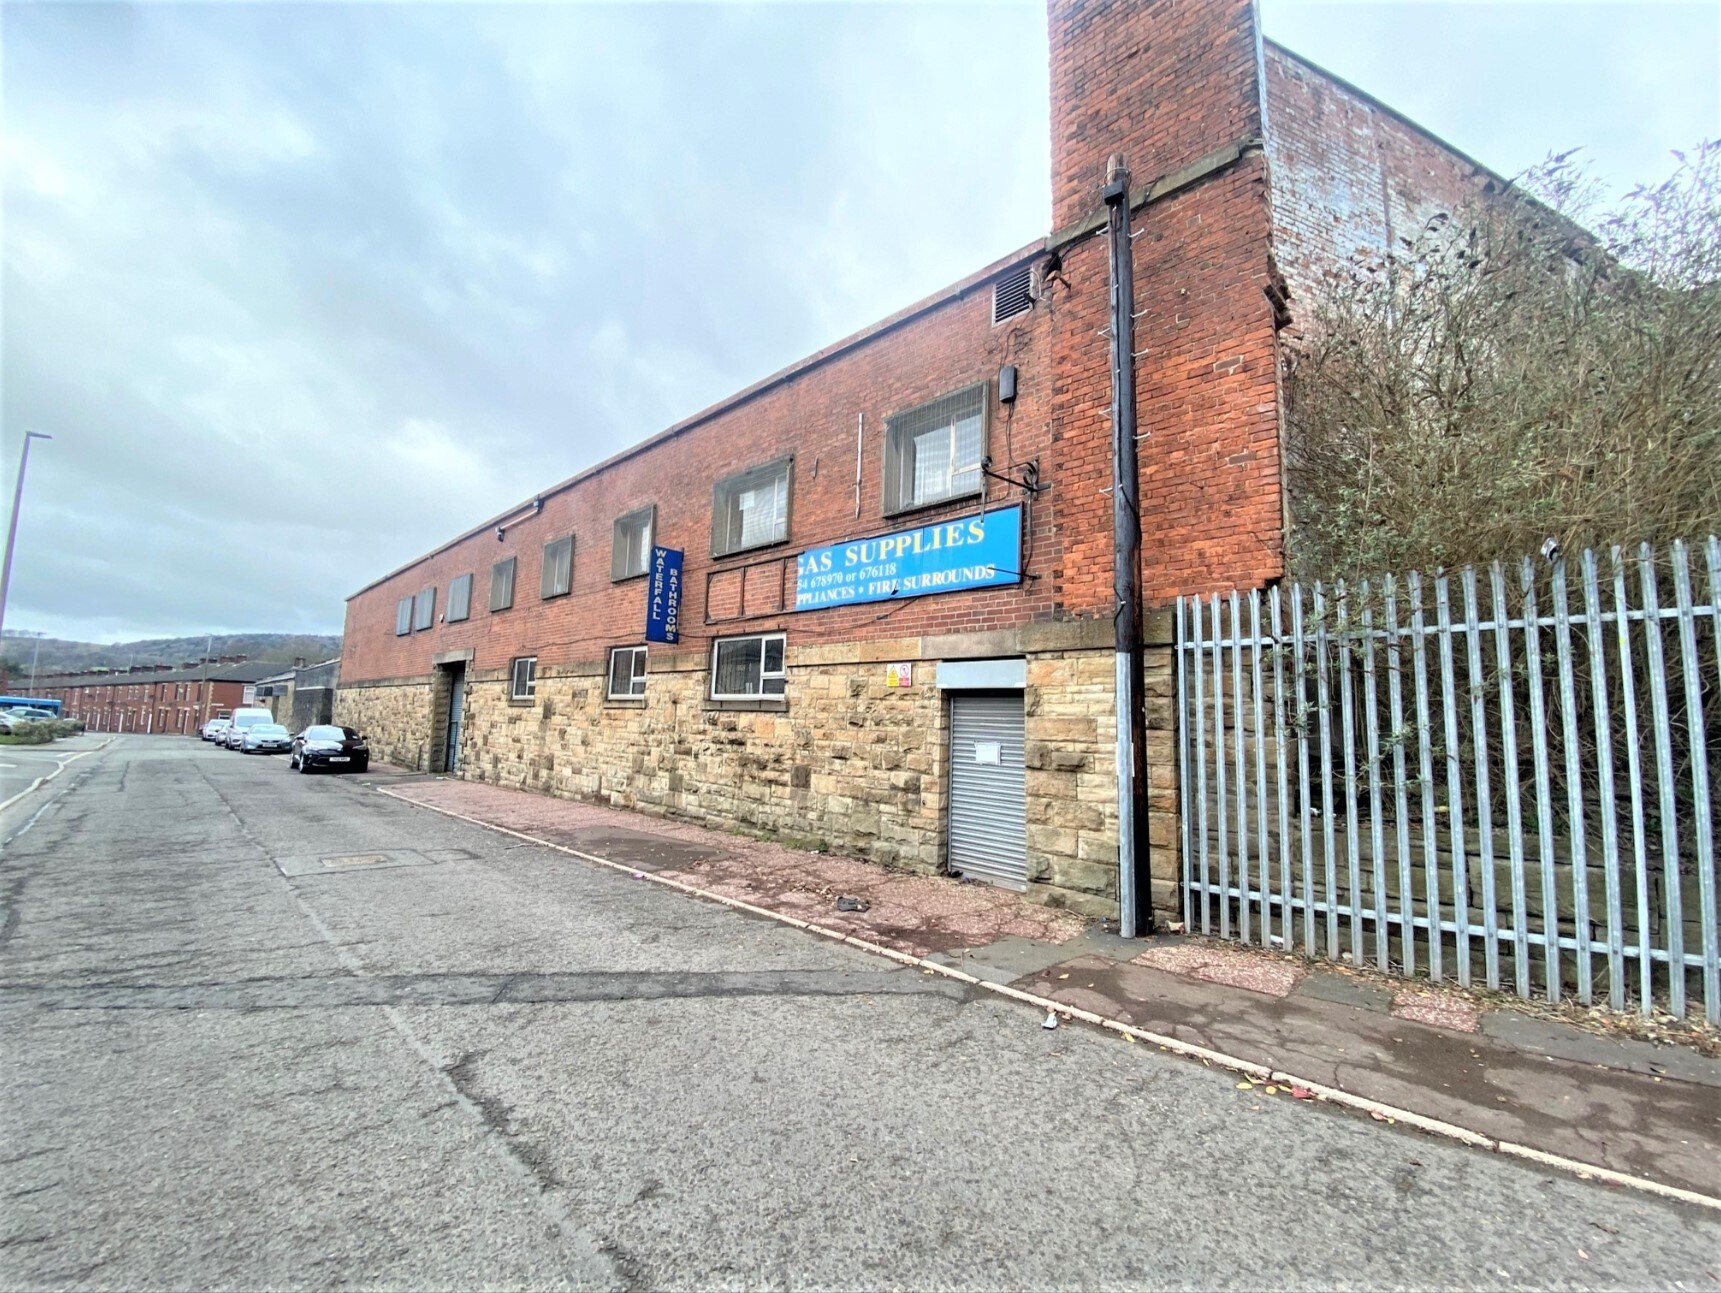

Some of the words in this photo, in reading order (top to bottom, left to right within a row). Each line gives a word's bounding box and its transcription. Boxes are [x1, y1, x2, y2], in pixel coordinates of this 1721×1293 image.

[845, 520, 985, 567] SUPPLIES
[653, 548, 667, 620] WATERFALL
[810, 572, 843, 588] 678970
[845, 572, 857, 582] or
[859, 562, 897, 580] 676118
[868, 579, 900, 595] FIRE
[903, 563, 996, 591] SURROUNDS
[665, 568, 678, 640] BATHROOMS
